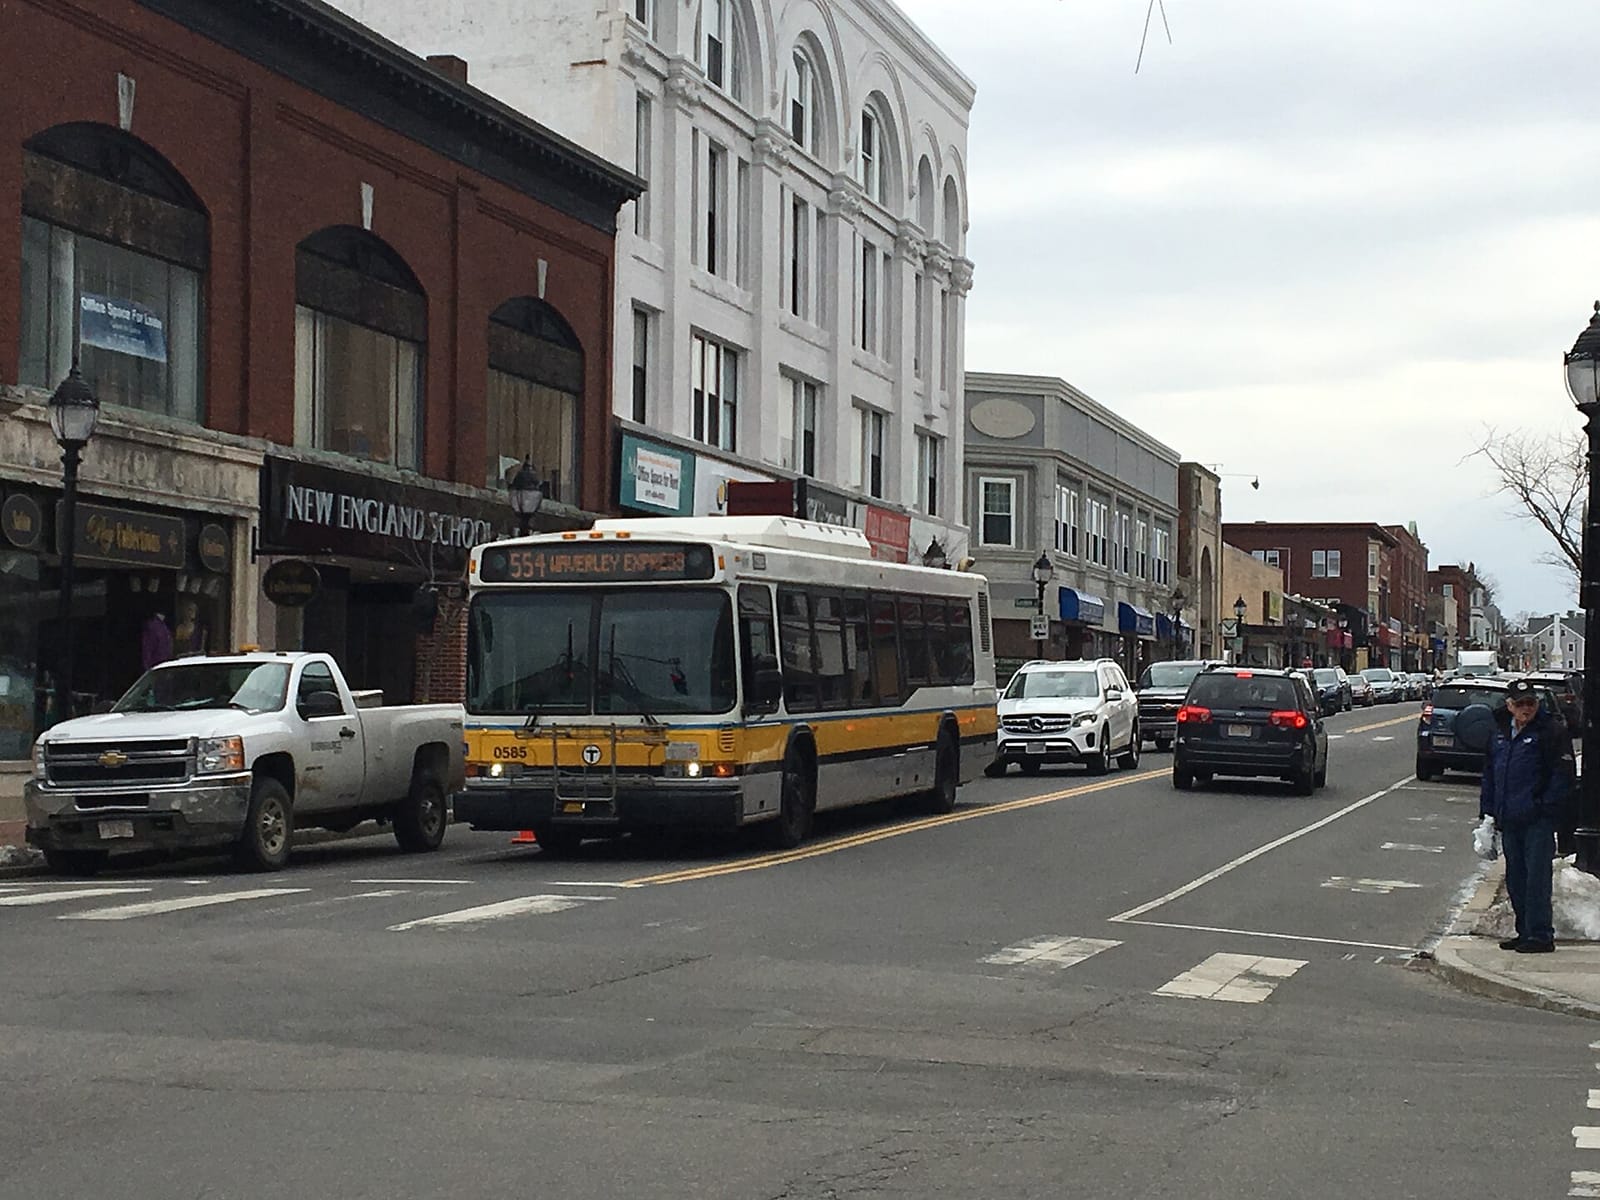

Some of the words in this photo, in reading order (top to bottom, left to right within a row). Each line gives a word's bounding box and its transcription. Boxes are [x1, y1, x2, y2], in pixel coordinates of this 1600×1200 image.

[288, 484, 333, 526] NEW
[339, 495, 425, 541] ENGLAND
[510, 552, 546, 579] 554
[550, 553, 621, 573] WAVERLEY
[623, 552, 685, 572] EXPRESS
[493, 746, 527, 759] 0585
